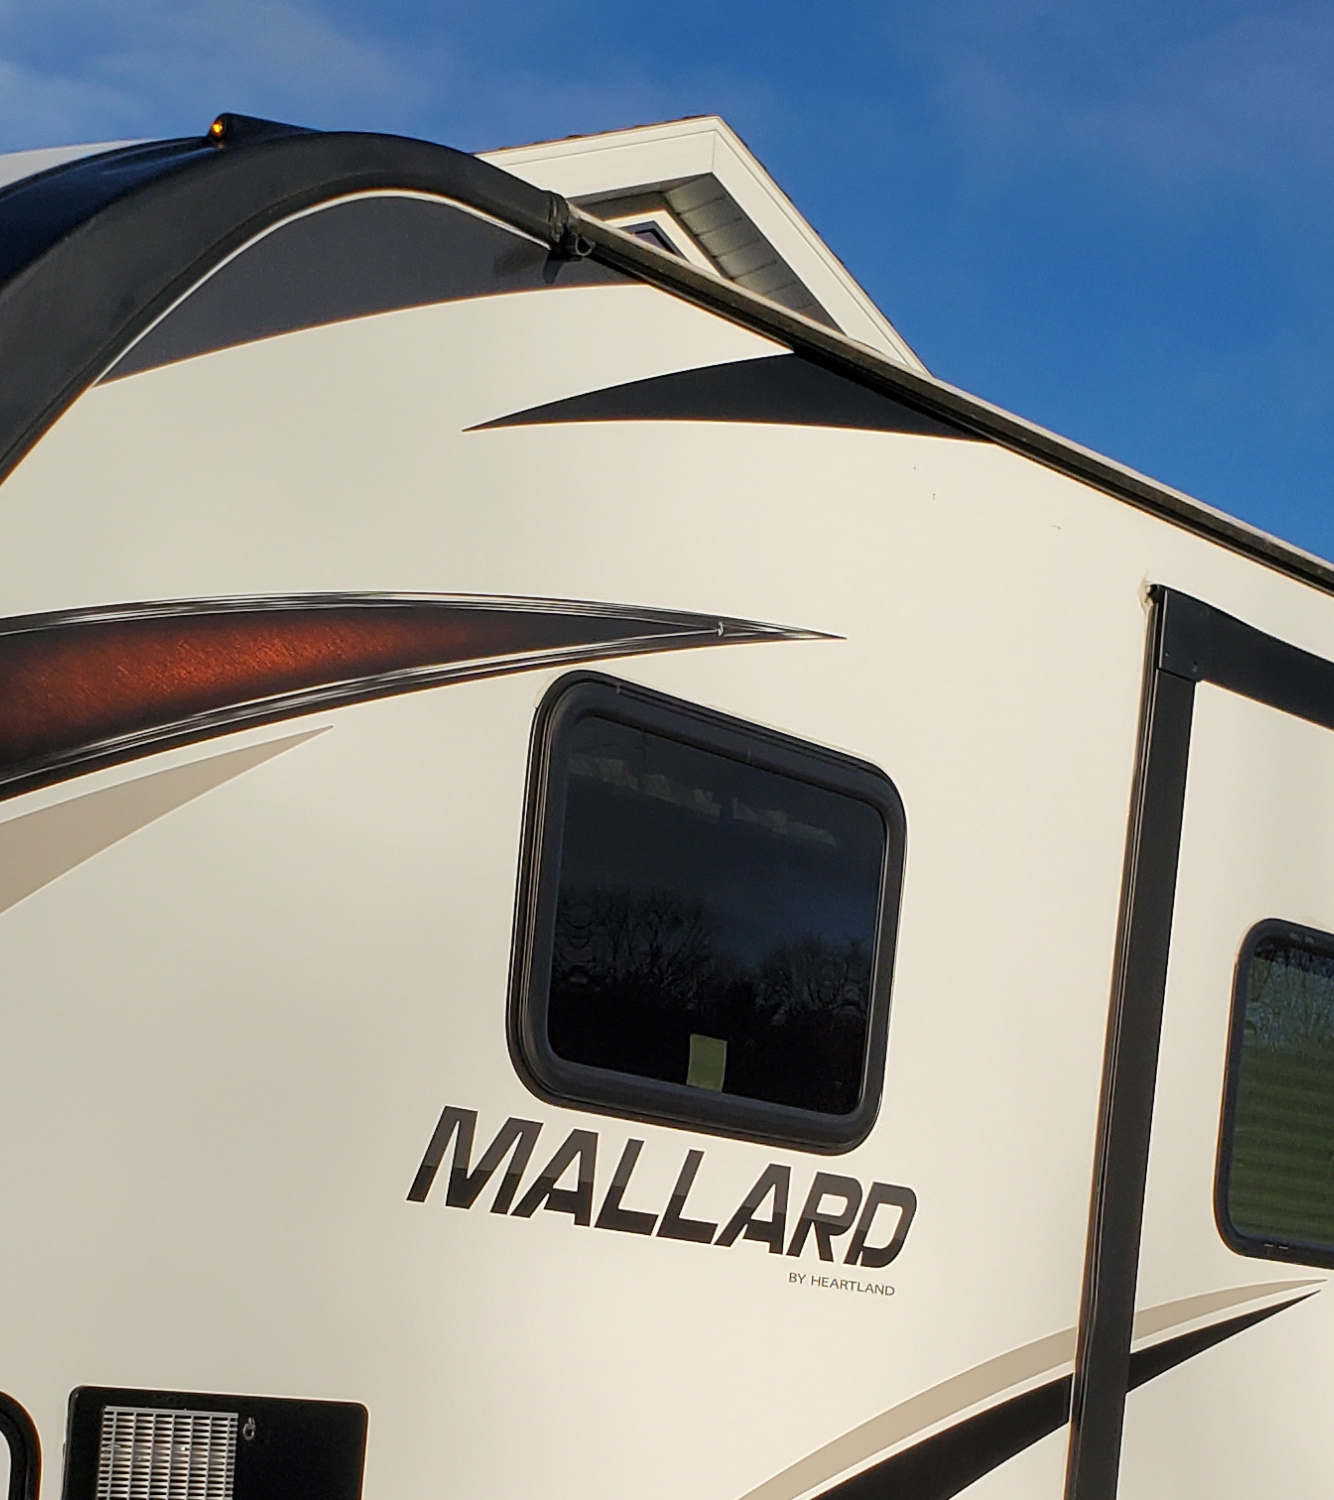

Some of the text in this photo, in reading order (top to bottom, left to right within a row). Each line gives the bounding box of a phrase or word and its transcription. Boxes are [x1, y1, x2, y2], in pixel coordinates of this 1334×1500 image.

[405, 1105, 918, 1269] MALLARD
[788, 1272, 896, 1296] BY HEARTLAND
